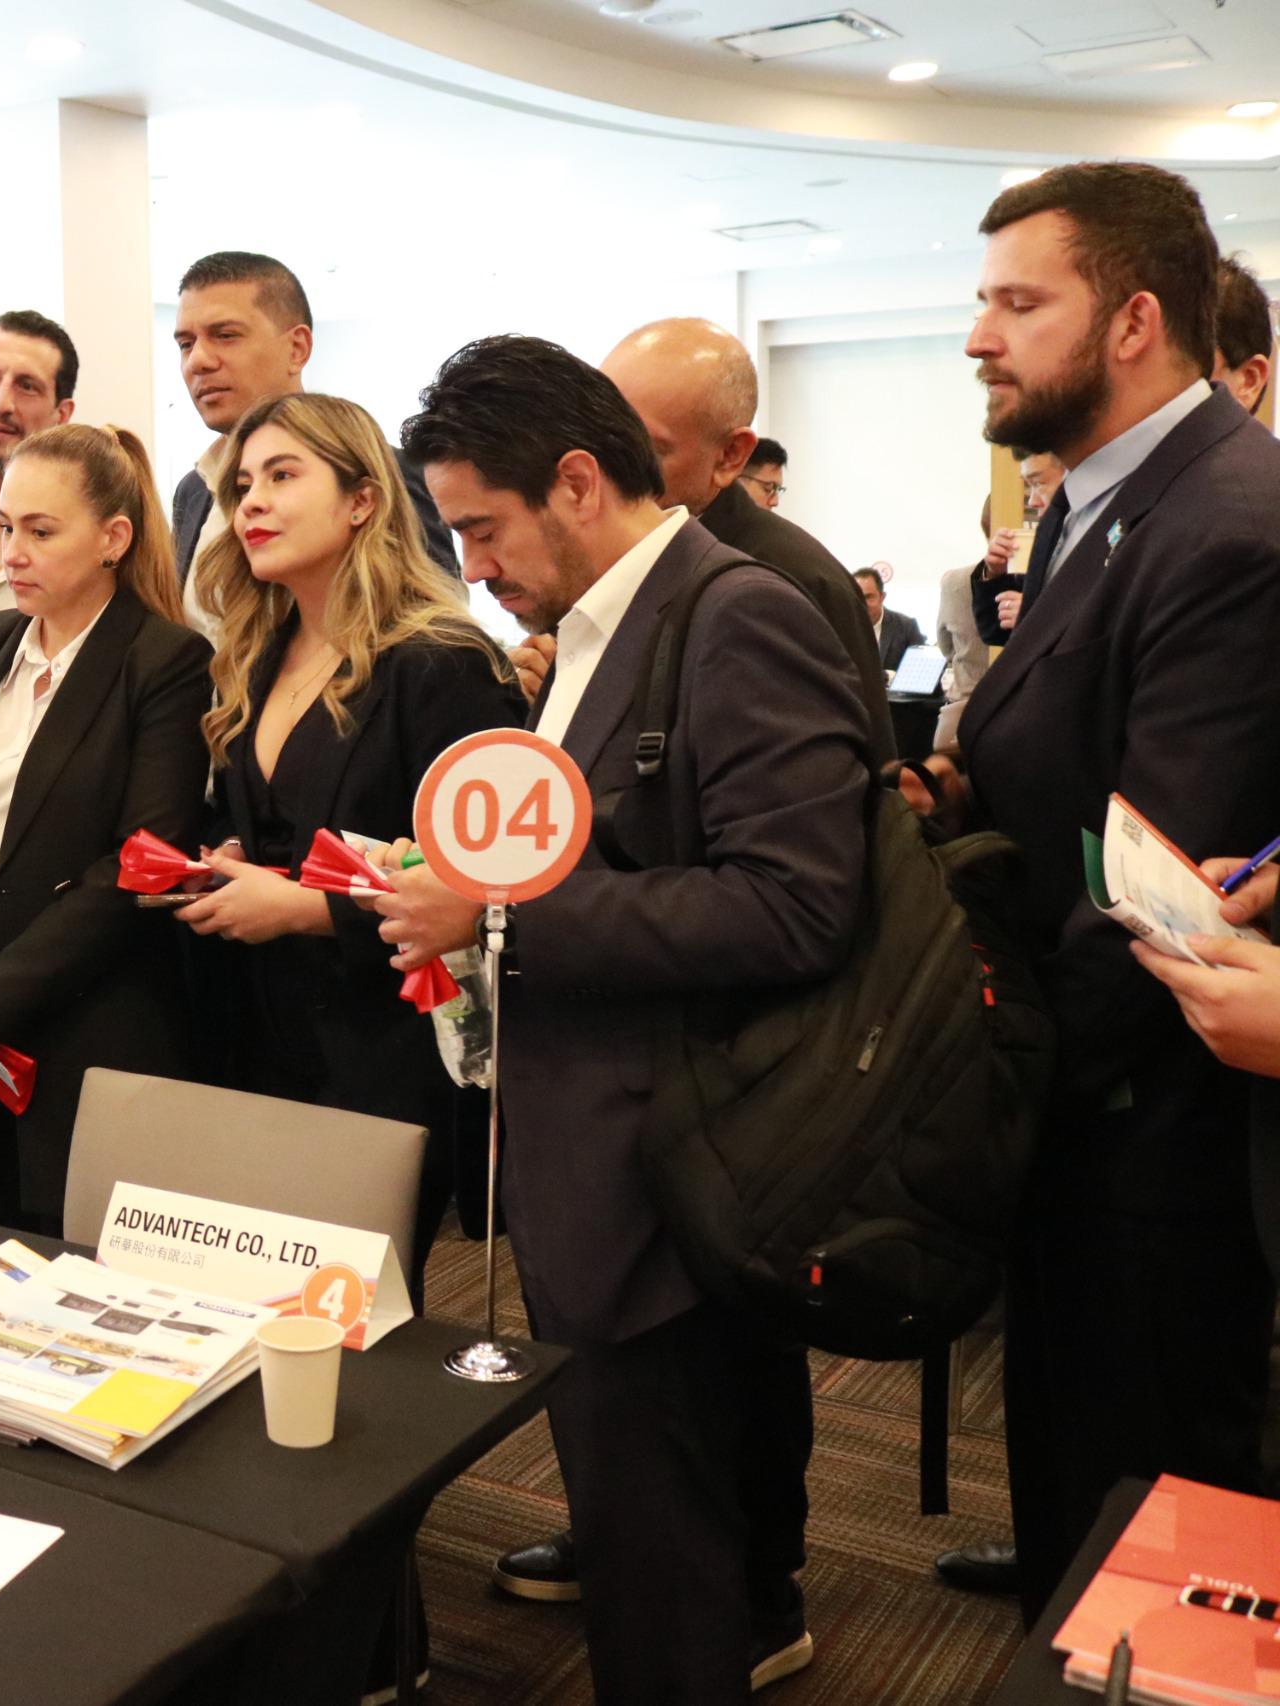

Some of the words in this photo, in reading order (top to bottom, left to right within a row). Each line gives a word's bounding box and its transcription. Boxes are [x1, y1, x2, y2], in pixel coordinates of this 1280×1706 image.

[453, 778, 558, 853] 04
[109, 1234, 206, 1269] 研華股份有限公司
[114, 1206, 231, 1249] ADVANTECH
[235, 1231, 272, 1263] CO.,
[278, 1240, 320, 1270] LTD.
[318, 1278, 348, 1321] 4
[1189, 1573, 1256, 1596] TOOLS
